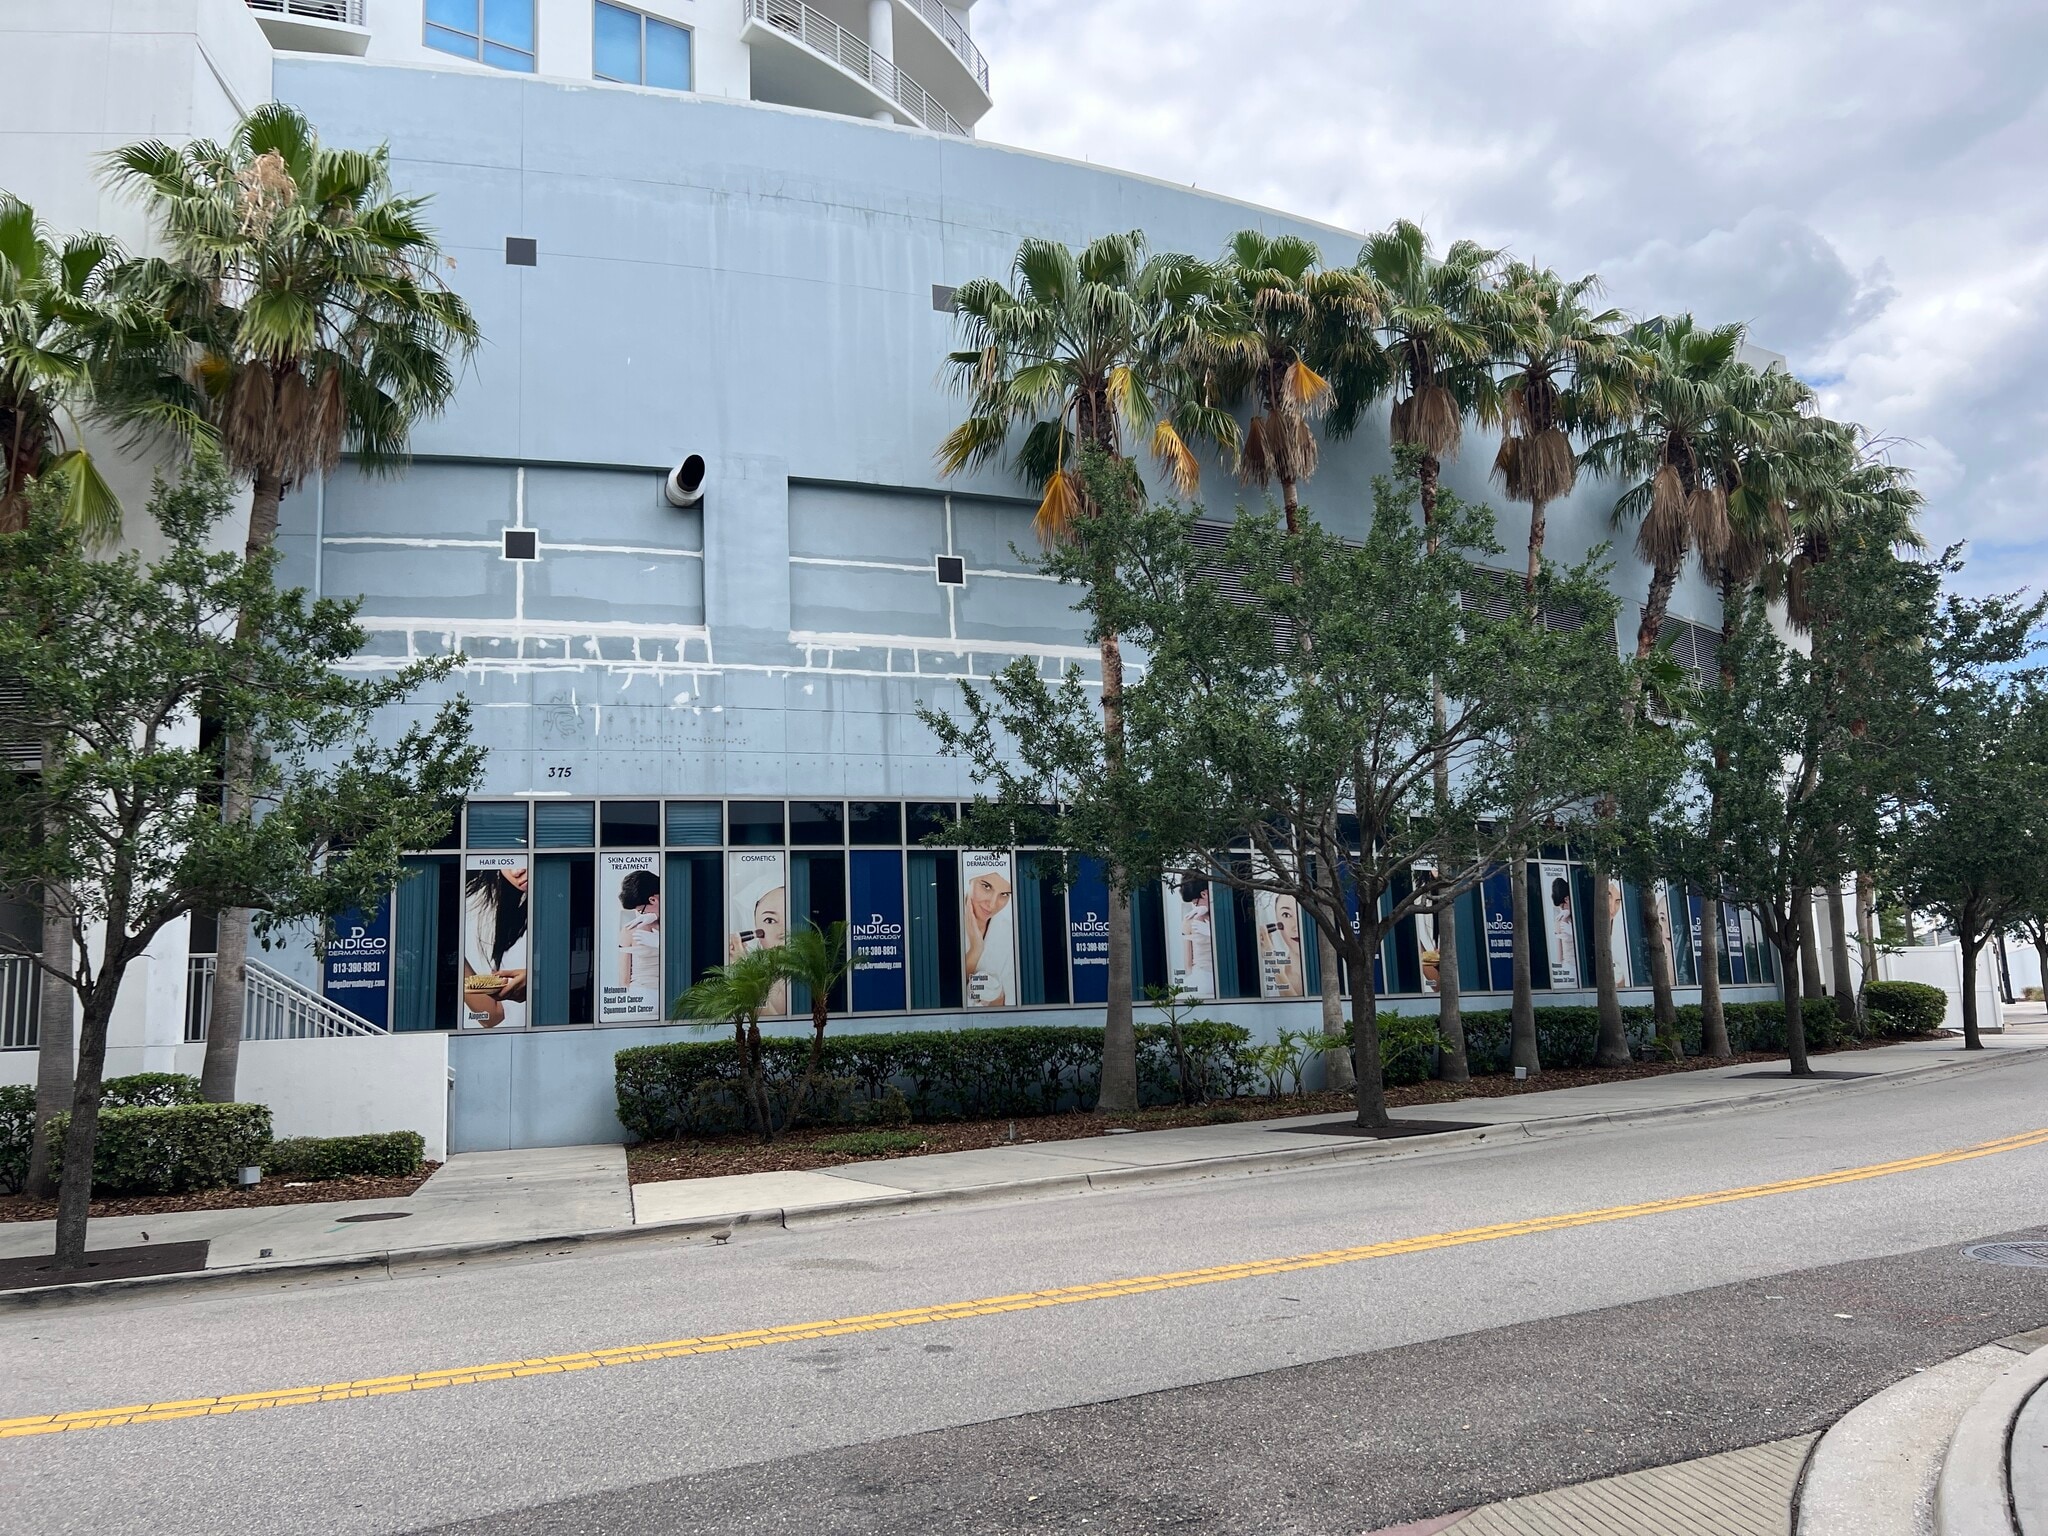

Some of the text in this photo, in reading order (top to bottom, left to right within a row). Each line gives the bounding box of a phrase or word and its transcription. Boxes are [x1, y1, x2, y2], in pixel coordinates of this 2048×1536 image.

[548, 766, 572, 778] 375
[498, 858, 515, 866] LOSS
[607, 856, 624, 864] SKIN
[611, 863, 649, 871] TREATMENT
[853, 923, 902, 935] INDIGO
[328, 937, 387, 950] INDIGO
[328, 949, 387, 957] DERMATOLOGY
[617, 995, 627, 1004] Cell
[628, 1005, 637, 1013] Cell
[637, 1005, 654, 1013] Cancer
